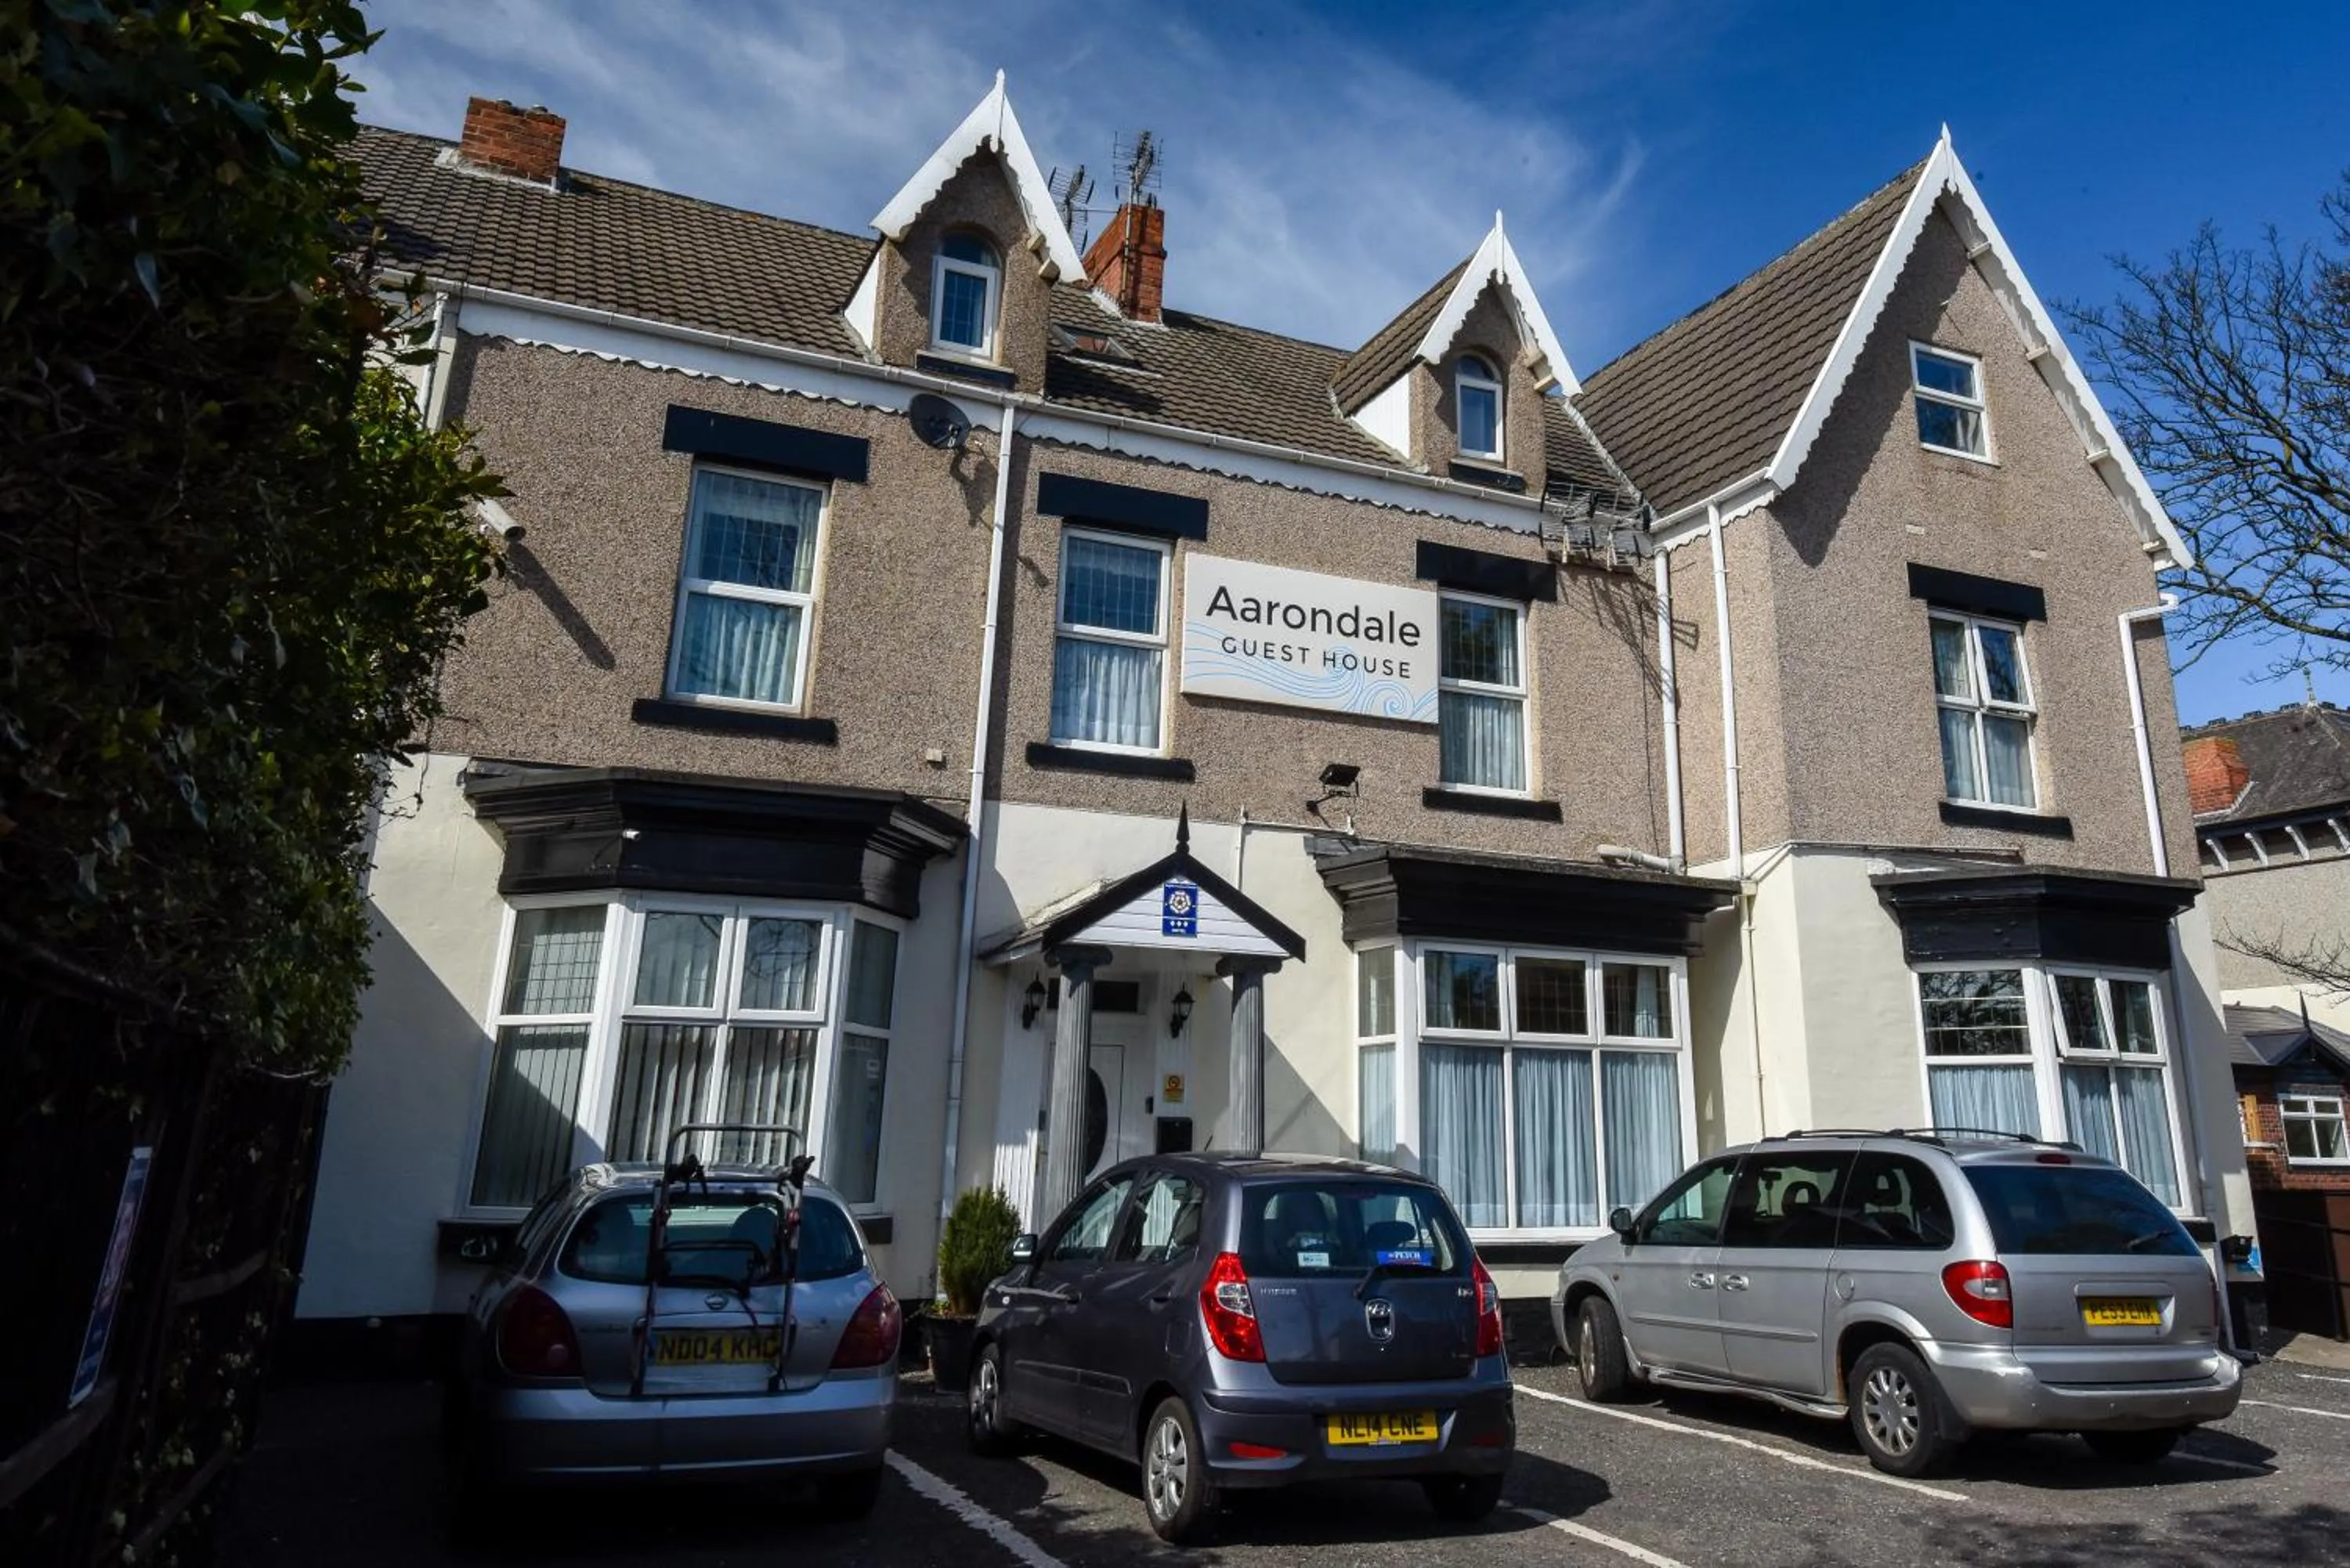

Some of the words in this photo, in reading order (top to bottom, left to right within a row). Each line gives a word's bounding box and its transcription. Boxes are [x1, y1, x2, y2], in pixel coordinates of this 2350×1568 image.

[1206, 585, 1420, 647] Aarondale
[1221, 637, 1310, 664] GUEST
[1322, 650, 1412, 679] HOUSE
[659, 1336, 722, 1360] ND04
[1340, 1414, 1383, 1438] NL14
[1388, 1414, 1425, 1436] CNE
